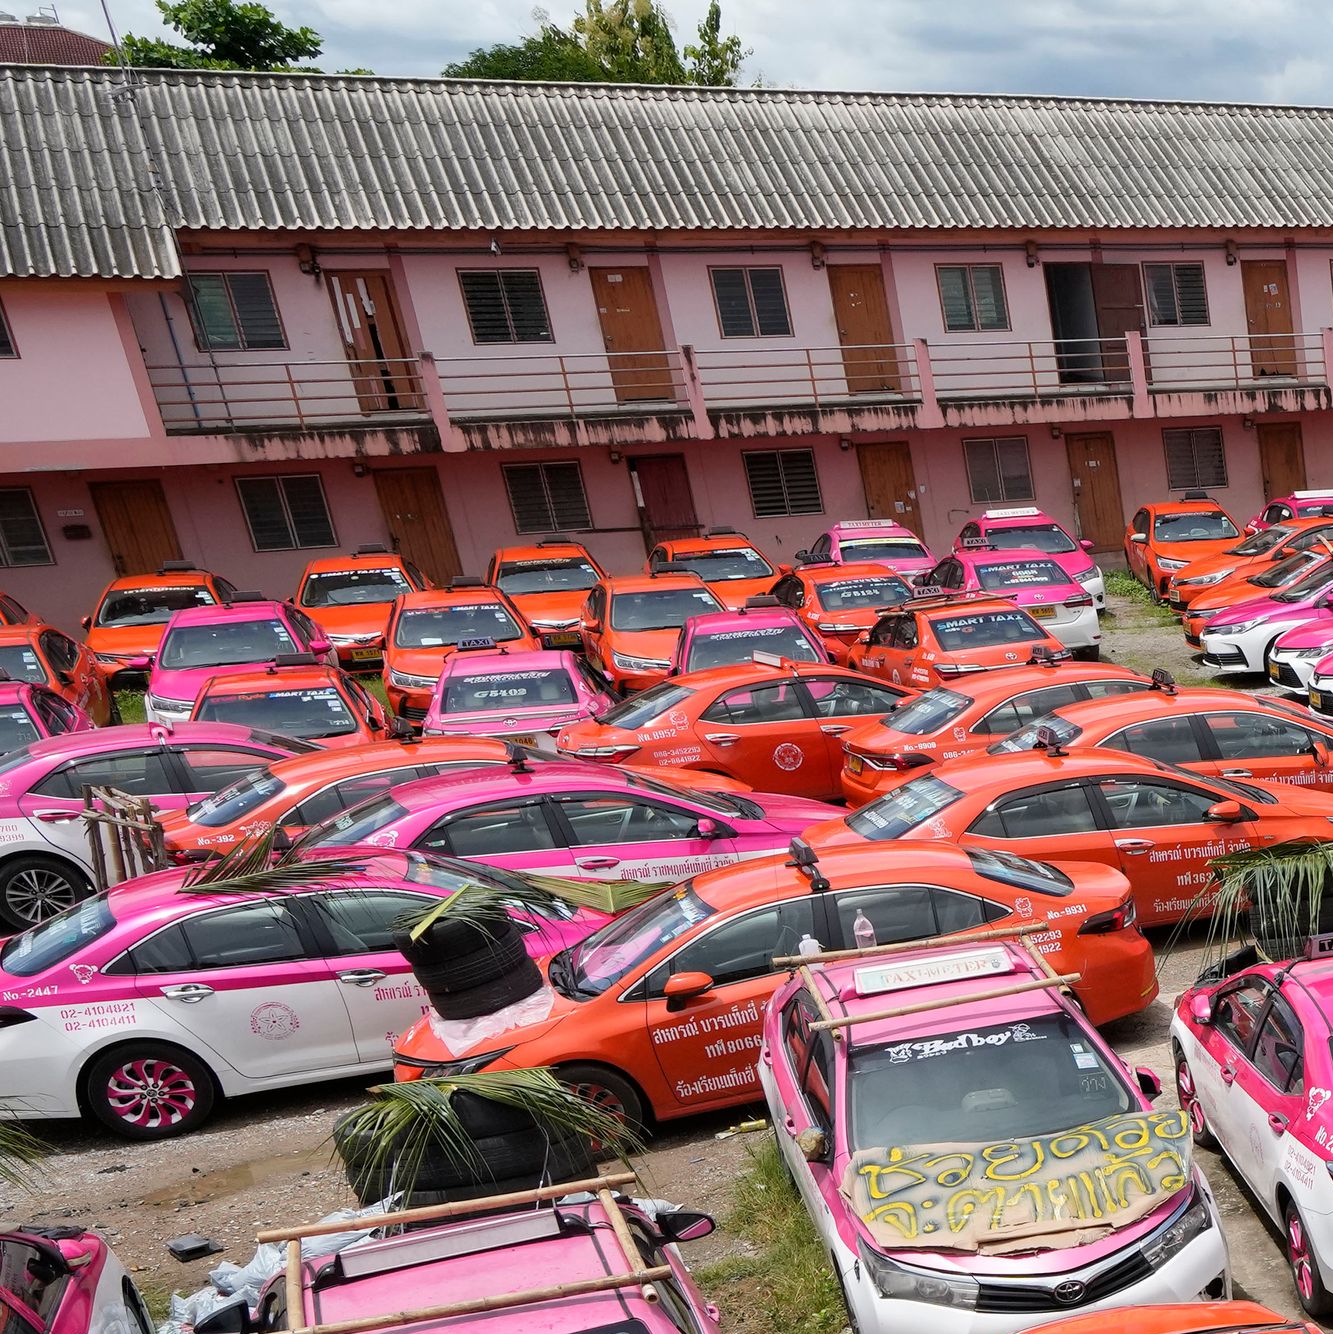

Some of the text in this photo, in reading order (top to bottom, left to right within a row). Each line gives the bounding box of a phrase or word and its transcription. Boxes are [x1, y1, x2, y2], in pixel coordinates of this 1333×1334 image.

[967, 538, 987, 546] TAXI
[917, 586, 941, 596] TAXI
[937, 614, 1023, 630] SMART TAXI
[463, 639, 492, 648] TAXI
[1047, 903, 1088, 921] No.-9931
[2, 984, 59, 1001] No.-2447
[60, 1003, 136, 1020] 02-4104821
[64, 1015, 138, 1033] 02-4104411
[653, 1016, 699, 1045] สหกรณ์
[726, 1035, 763, 1054] 8066
